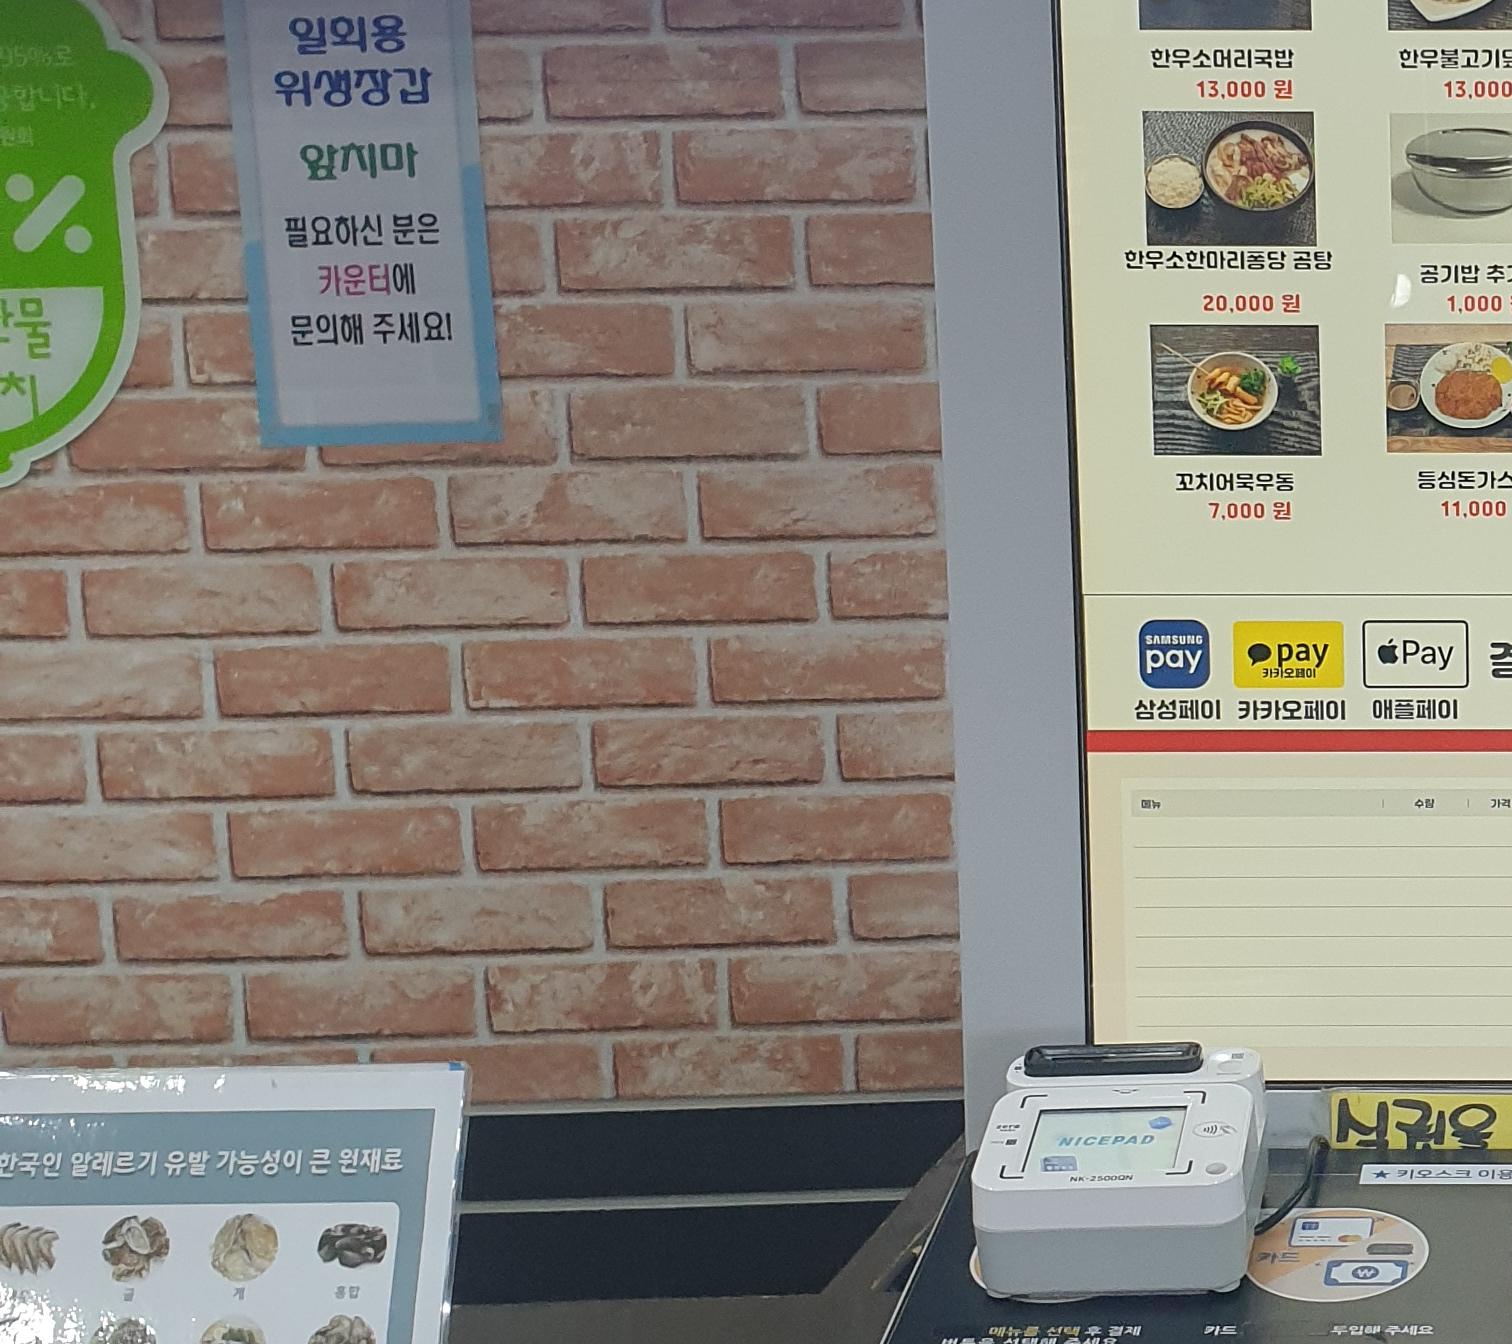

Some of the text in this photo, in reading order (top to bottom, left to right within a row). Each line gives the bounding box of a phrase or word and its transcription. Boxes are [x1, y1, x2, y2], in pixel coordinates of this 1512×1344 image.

[287, 14, 408, 56] 일회용
[1150, 47, 1294, 71] 한우소머리국밥
[273, 67, 434, 107] 위생장갑
[1195, 78, 1294, 100] 13,000 원
[299, 142, 419, 182] 앞치마
[284, 212, 441, 249] 필요하신 분은
[1292, 249, 1333, 272] 곰탕
[318, 262, 417, 298] 카운터에
[1419, 264, 1480, 286] 공기밥
[1202, 292, 1302, 314] 20,000 원
[1446, 293, 1503, 314] 1,000
[290, 311, 454, 347] 문의해 주세요!
[1175, 471, 1295, 494] 꼬치어묵우동
[1208, 500, 1293, 522] 7,000 원
[1440, 499, 1509, 521] 11,000
[1145, 634, 1203, 646] SAMSUNG
[1145, 648, 1203, 674] pay
[1277, 640, 1330, 669] pay
[1402, 639, 1455, 671] Pay
[1262, 667, 1317, 680] 카카오페이
[1135, 698, 1222, 722] 삼성페이
[1237, 698, 1347, 722] 카카오페이
[1372, 698, 1459, 722] 애플페이
[1489, 798, 1512, 811] 가격
[1056, 1133, 1156, 1148] NICEPAD
[70, 1150, 159, 1178] 알레르기
[164, 1149, 211, 1177] 유발
[215, 1148, 304, 1177] 가능성이
[308, 1148, 332, 1176] 큰
[337, 1147, 404, 1175] 원재료
[1396, 1166, 1473, 1181] 키오스크
[1069, 1173, 1134, 1183] NK-2500QN
[1203, 1324, 1239, 1337] 카드
[1330, 1324, 1435, 1337] 투입해 주세요
